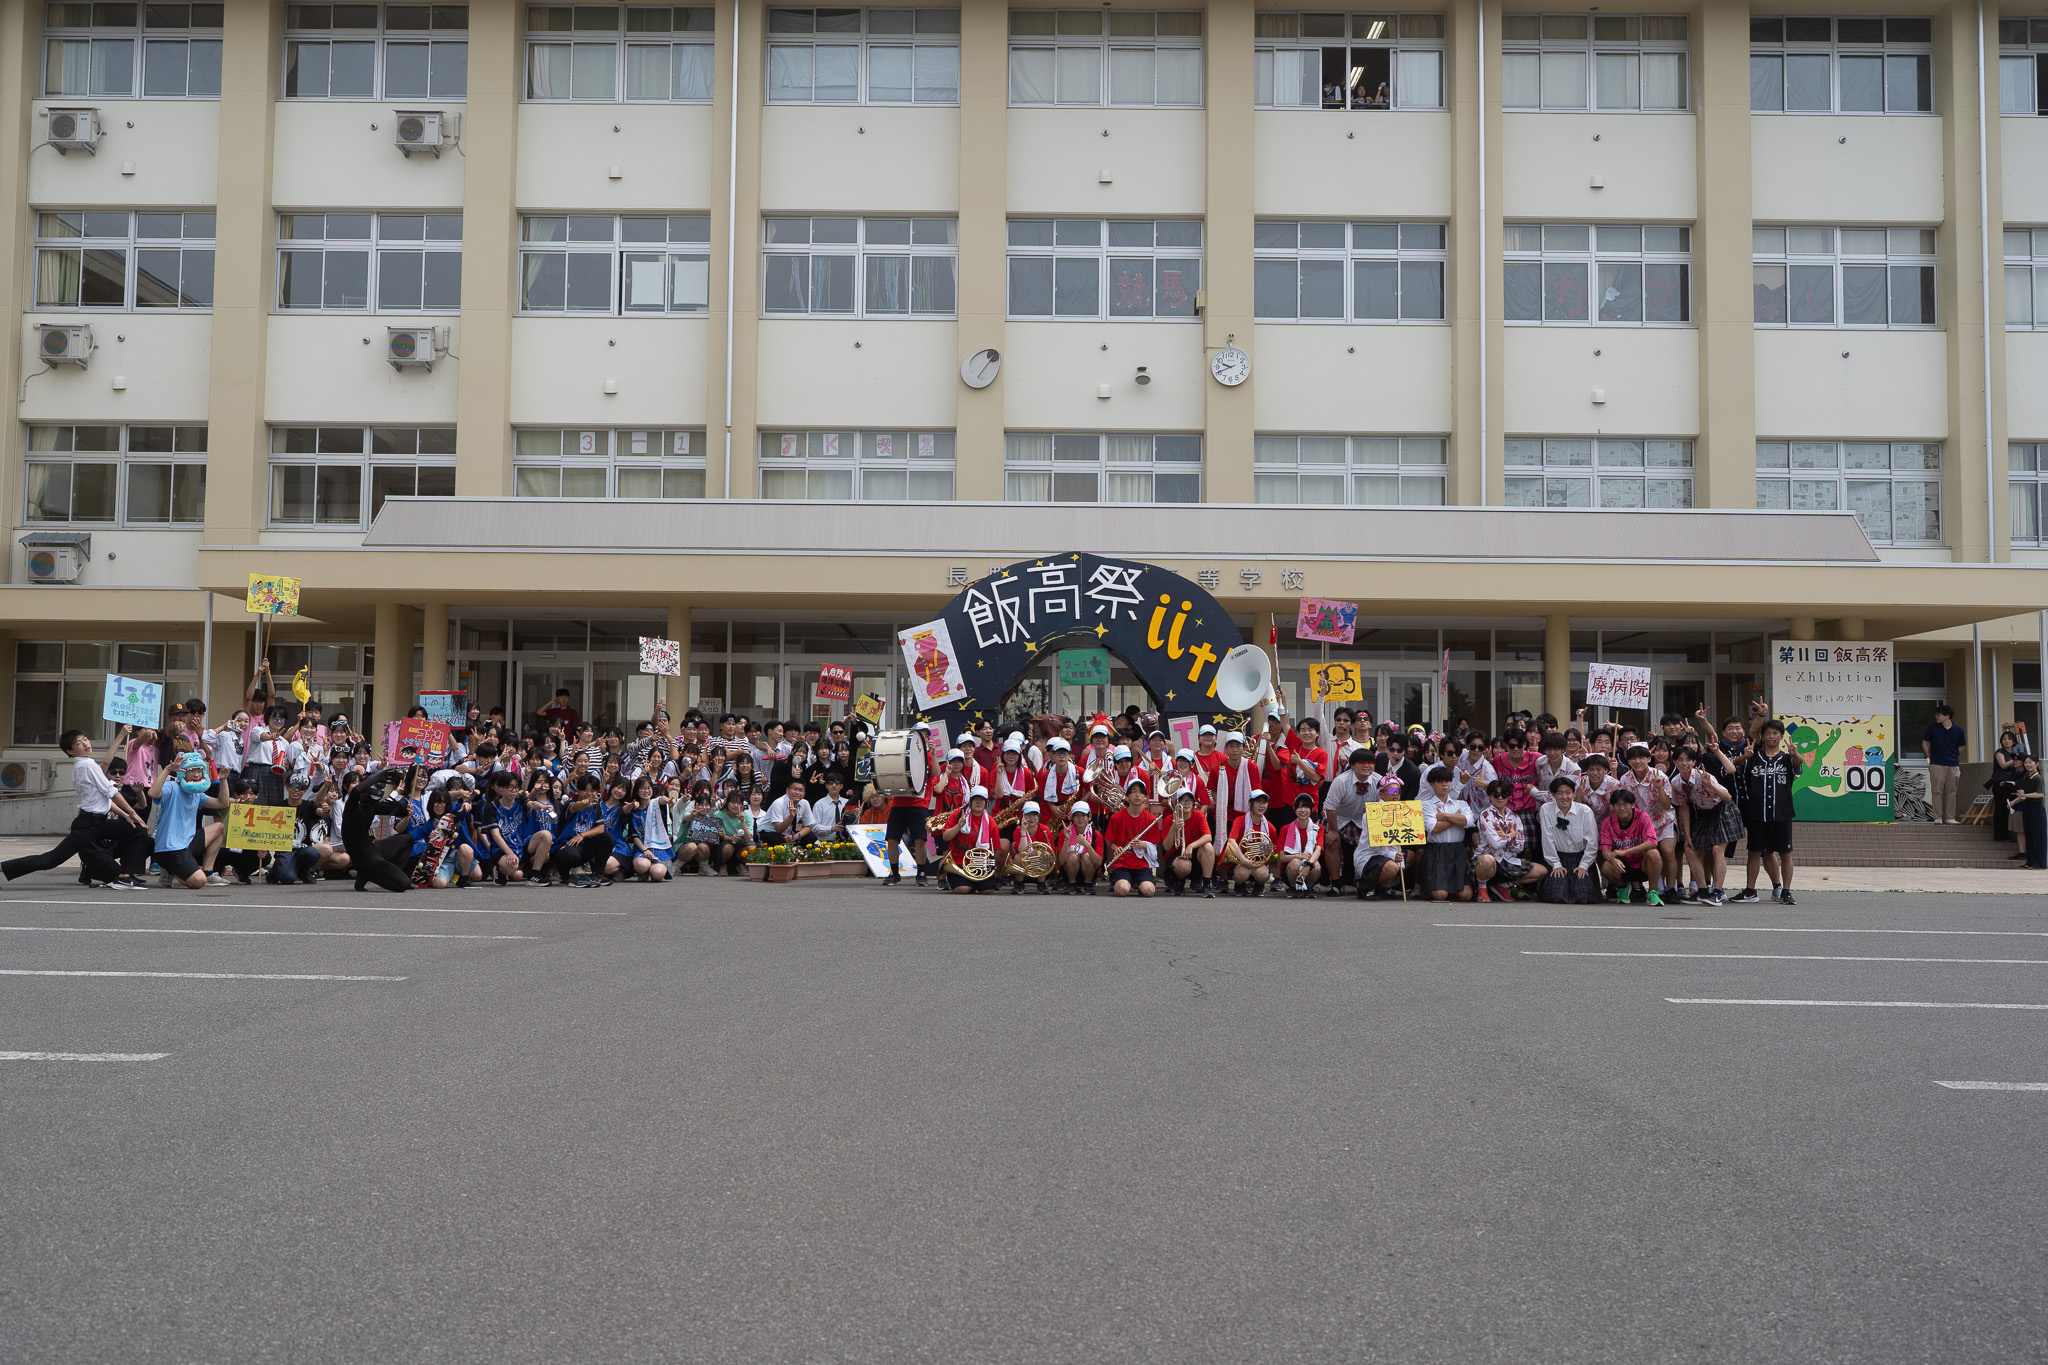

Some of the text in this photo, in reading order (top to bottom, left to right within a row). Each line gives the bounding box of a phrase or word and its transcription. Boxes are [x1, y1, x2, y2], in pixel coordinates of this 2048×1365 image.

[962, 562, 1145, 649] 飯高祭
[1833, 646, 1888, 662] 飯高祭
[113, 676, 157, 704] 1-4
[1591, 676, 1650, 698] 廃病院
[1777, 775, 1787, 785] 33
[1820, 765, 1841, 776] あと
[1846, 766, 1885, 791] 00
[1878, 794, 1888, 806] 日
[244, 807, 287, 830] 1-4
[1382, 828, 1419, 844] 喫茶
